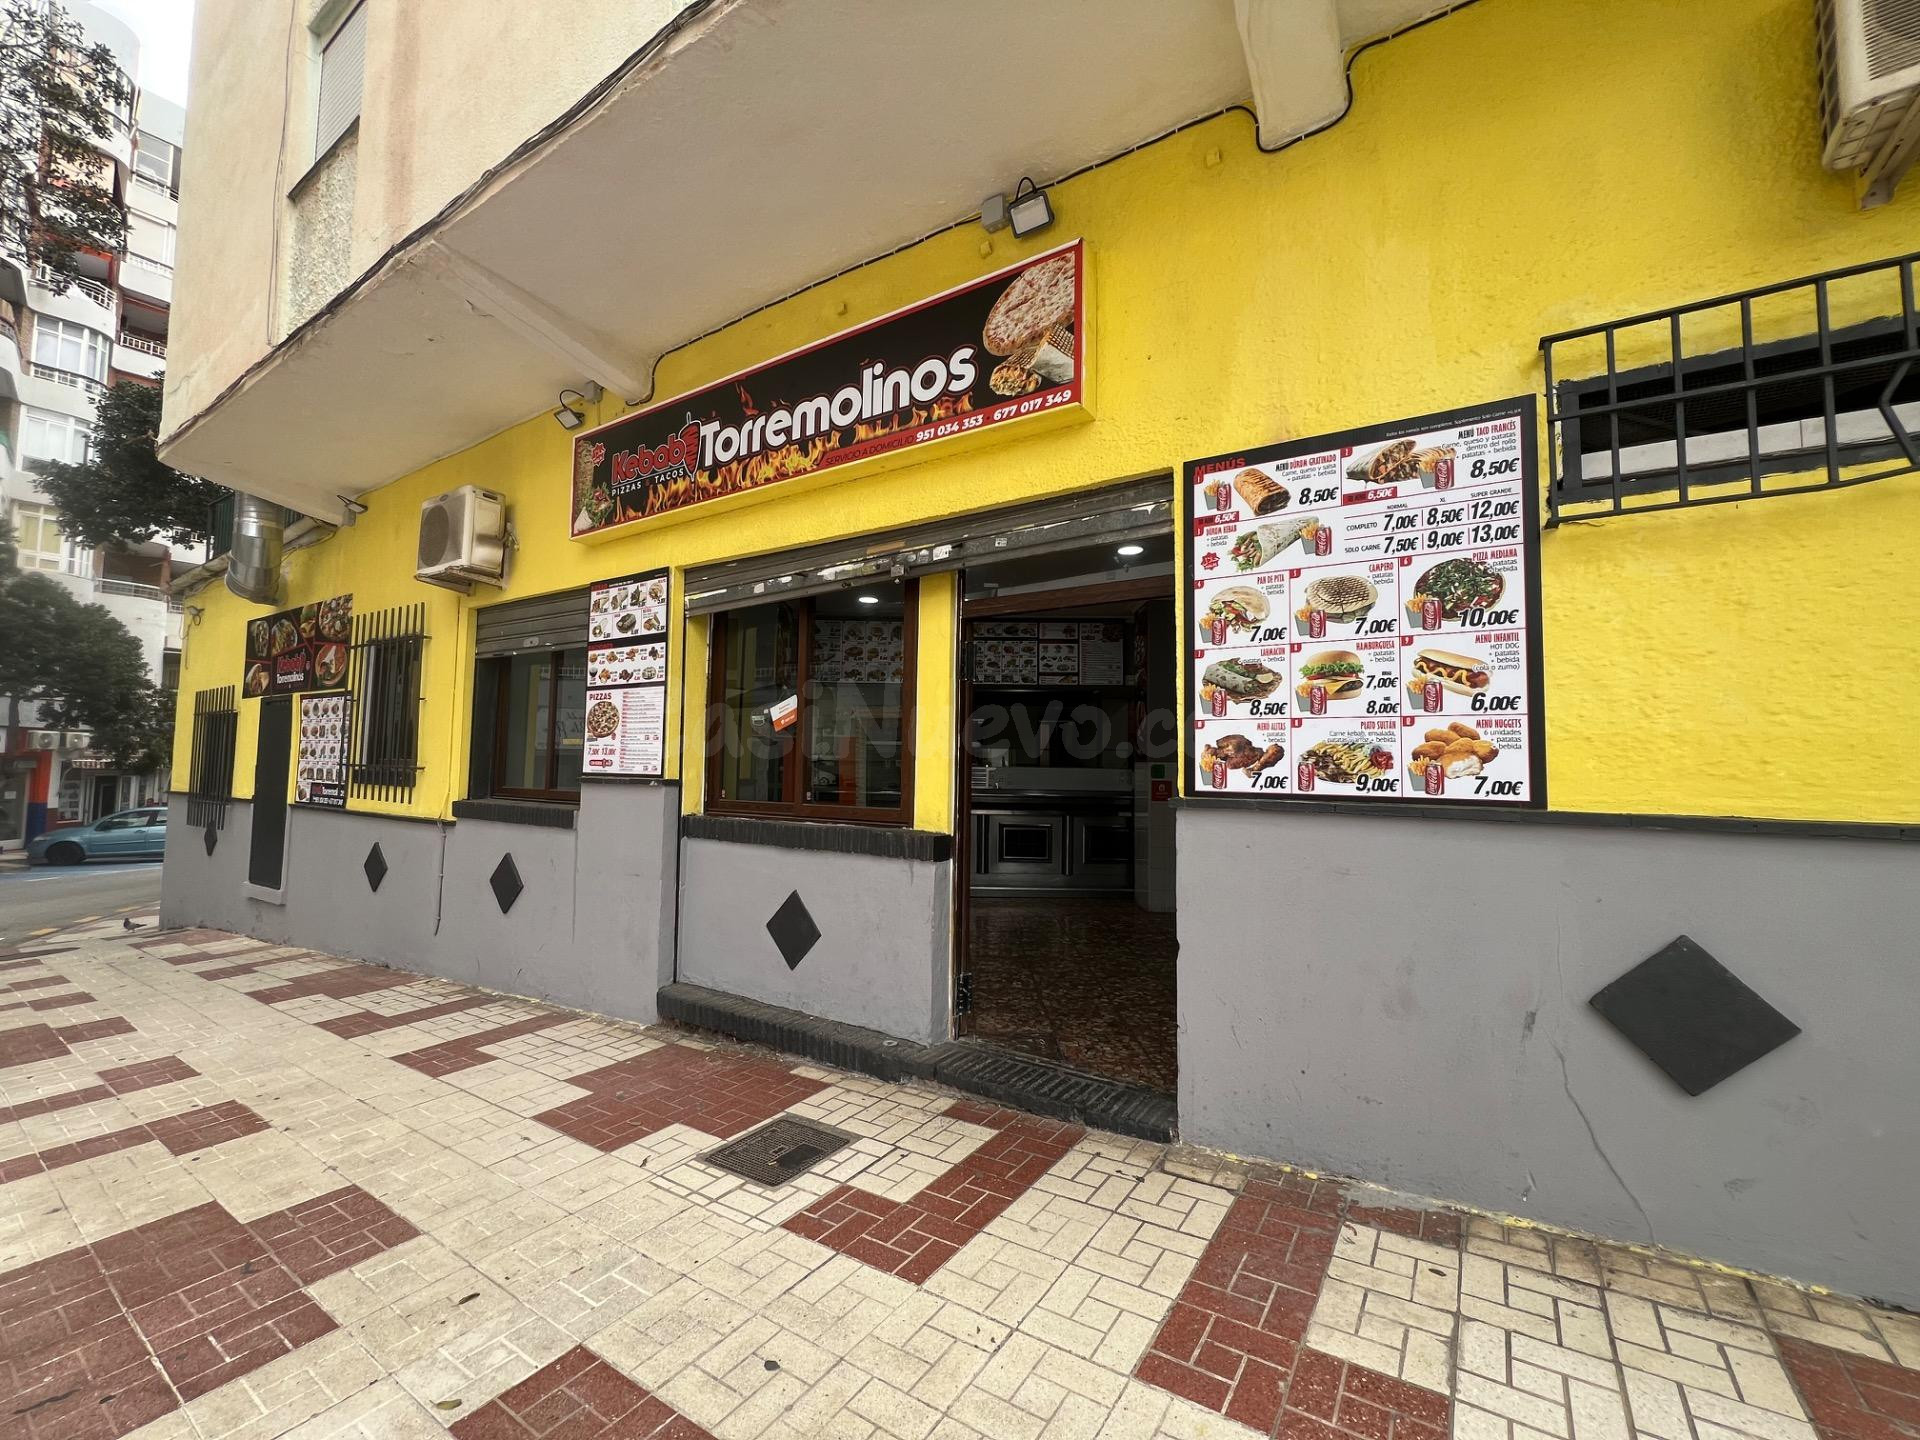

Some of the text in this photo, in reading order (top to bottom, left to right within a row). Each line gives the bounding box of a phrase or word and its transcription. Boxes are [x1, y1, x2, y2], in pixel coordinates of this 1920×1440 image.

[700, 348, 977, 467] Torremolinos
[825, 451, 861, 465] SERVICIO
[868, 435, 915, 456] DOMICILIO
[915, 429, 936, 443] 951
[937, 423, 960, 438] 034
[961, 415, 984, 430] 353
[993, 405, 1016, 421] 677
[1020, 398, 1042, 414] 017
[1045, 389, 1072, 407] 349
[1458, 421, 1516, 440] MENÚ TACO FRANCÉS
[1463, 437, 1484, 448] queso
[1491, 431, 1516, 441] patatas
[1466, 437, 1516, 451] dentro del rollo
[612, 433, 686, 486] Kebab
[1462, 445, 1517, 460] patatas bebida
[1195, 457, 1247, 475] MENÚS
[1470, 457, 1520, 480] 8,50€
[611, 468, 684, 497] PIZZAS TACOS
[1299, 487, 1339, 505] 8,50€
[1367, 488, 1394, 500] 6,50€
[1470, 487, 1512, 498] SUPER GRANDE
[1214, 512, 1236, 523] 6,50€
[1346, 500, 1519, 532] COMPLETO 7,00€ 8,50€ 12,00€
[1344, 524, 1520, 554] SOLO CARNE 7,50€ 9,00€ 13,00€
[1472, 548, 1518, 561] PIZZA MEDIANA
[1493, 559, 1518, 567] patatas
[1369, 562, 1394, 573] CAMPERO
[1257, 576, 1266, 584] PAN
[1267, 575, 1273, 583] DE
[1459, 607, 1519, 628] 10,00€
[1250, 625, 1287, 643] 7,00€
[1355, 617, 1397, 636] 7,00€
[1356, 641, 1395, 651] HAMBURGUESA
[1475, 632, 1519, 644] MENÚ INFANTIL
[1496, 656, 1520, 664] bebida
[1497, 663, 1520, 671] zumo)
[1366, 675, 1398, 690] 7,00€
[589, 692, 612, 701] PIZZAS
[1471, 692, 1521, 713] 6,00€
[1250, 699, 1288, 717] 8,50€
[1366, 700, 1399, 715] 8,00€
[1360, 719, 1396, 730] PLATO SULTÁN
[1476, 718, 1522, 729] MENÚ NUGGETS
[1251, 772, 1288, 791] 7,00€
[1356, 774, 1399, 794] 9,00€
[1474, 775, 1523, 797] 7,00€
